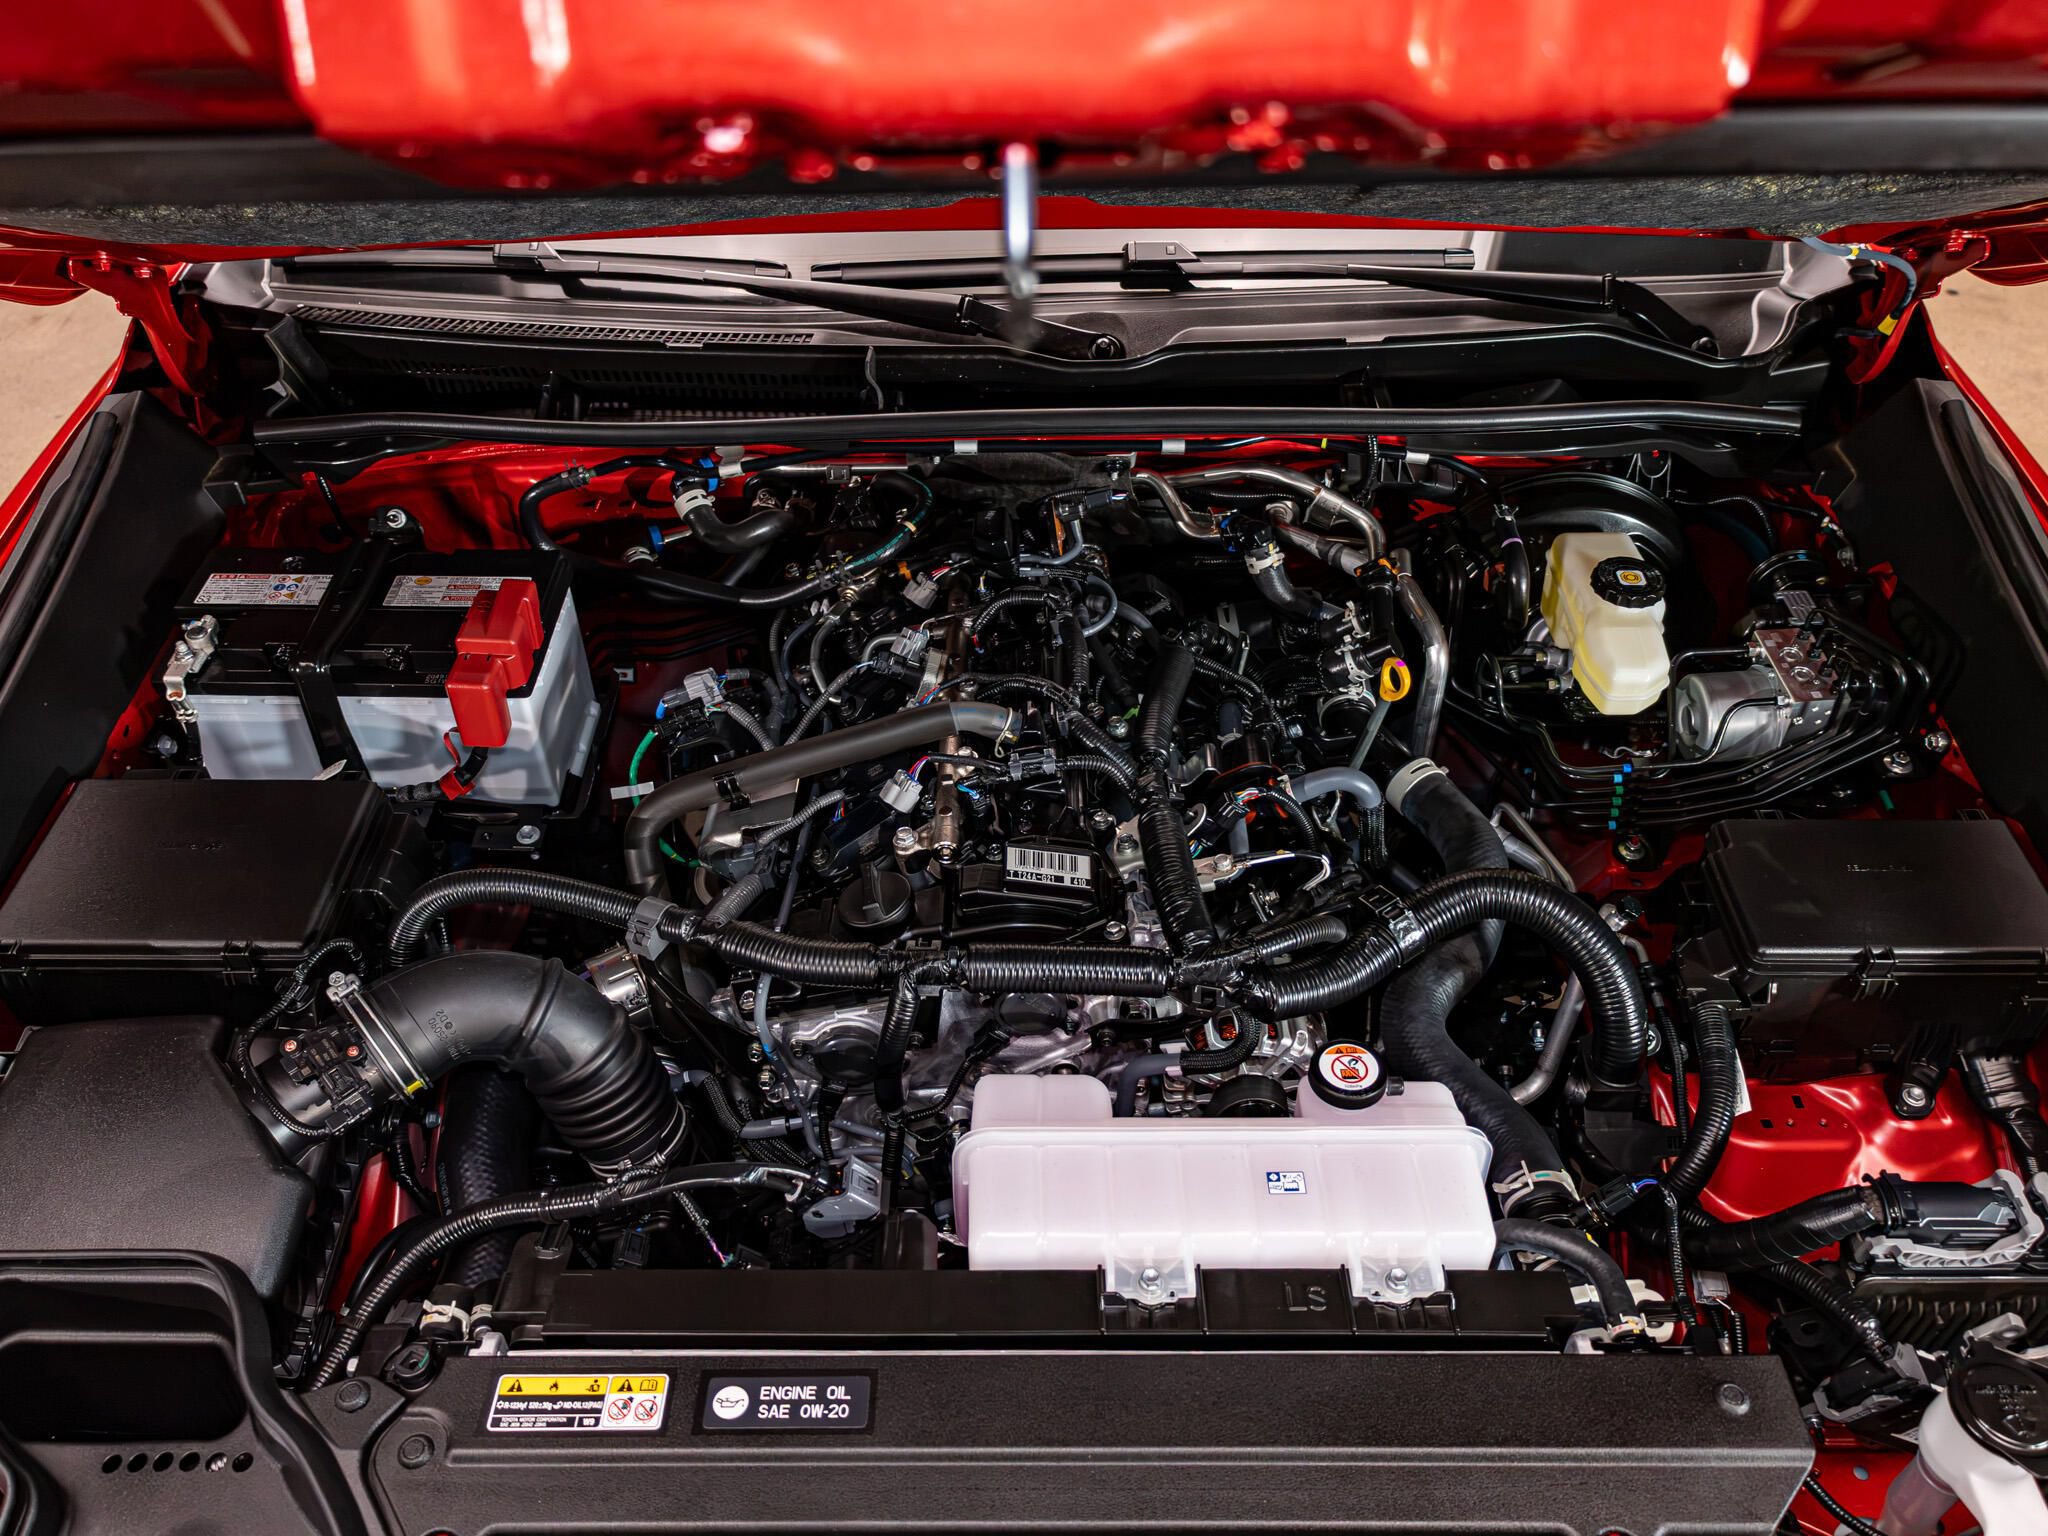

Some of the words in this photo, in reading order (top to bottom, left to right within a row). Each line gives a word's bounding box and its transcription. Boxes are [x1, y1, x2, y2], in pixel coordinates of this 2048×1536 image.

[1018, 871, 1055, 883] T24A-G21
[1284, 1281, 1327, 1311] LS
[759, 1385, 817, 1400] ENGINE
[826, 1385, 851, 1400] OIL
[757, 1404, 791, 1419] SAE
[799, 1404, 850, 1418] 0W-20
